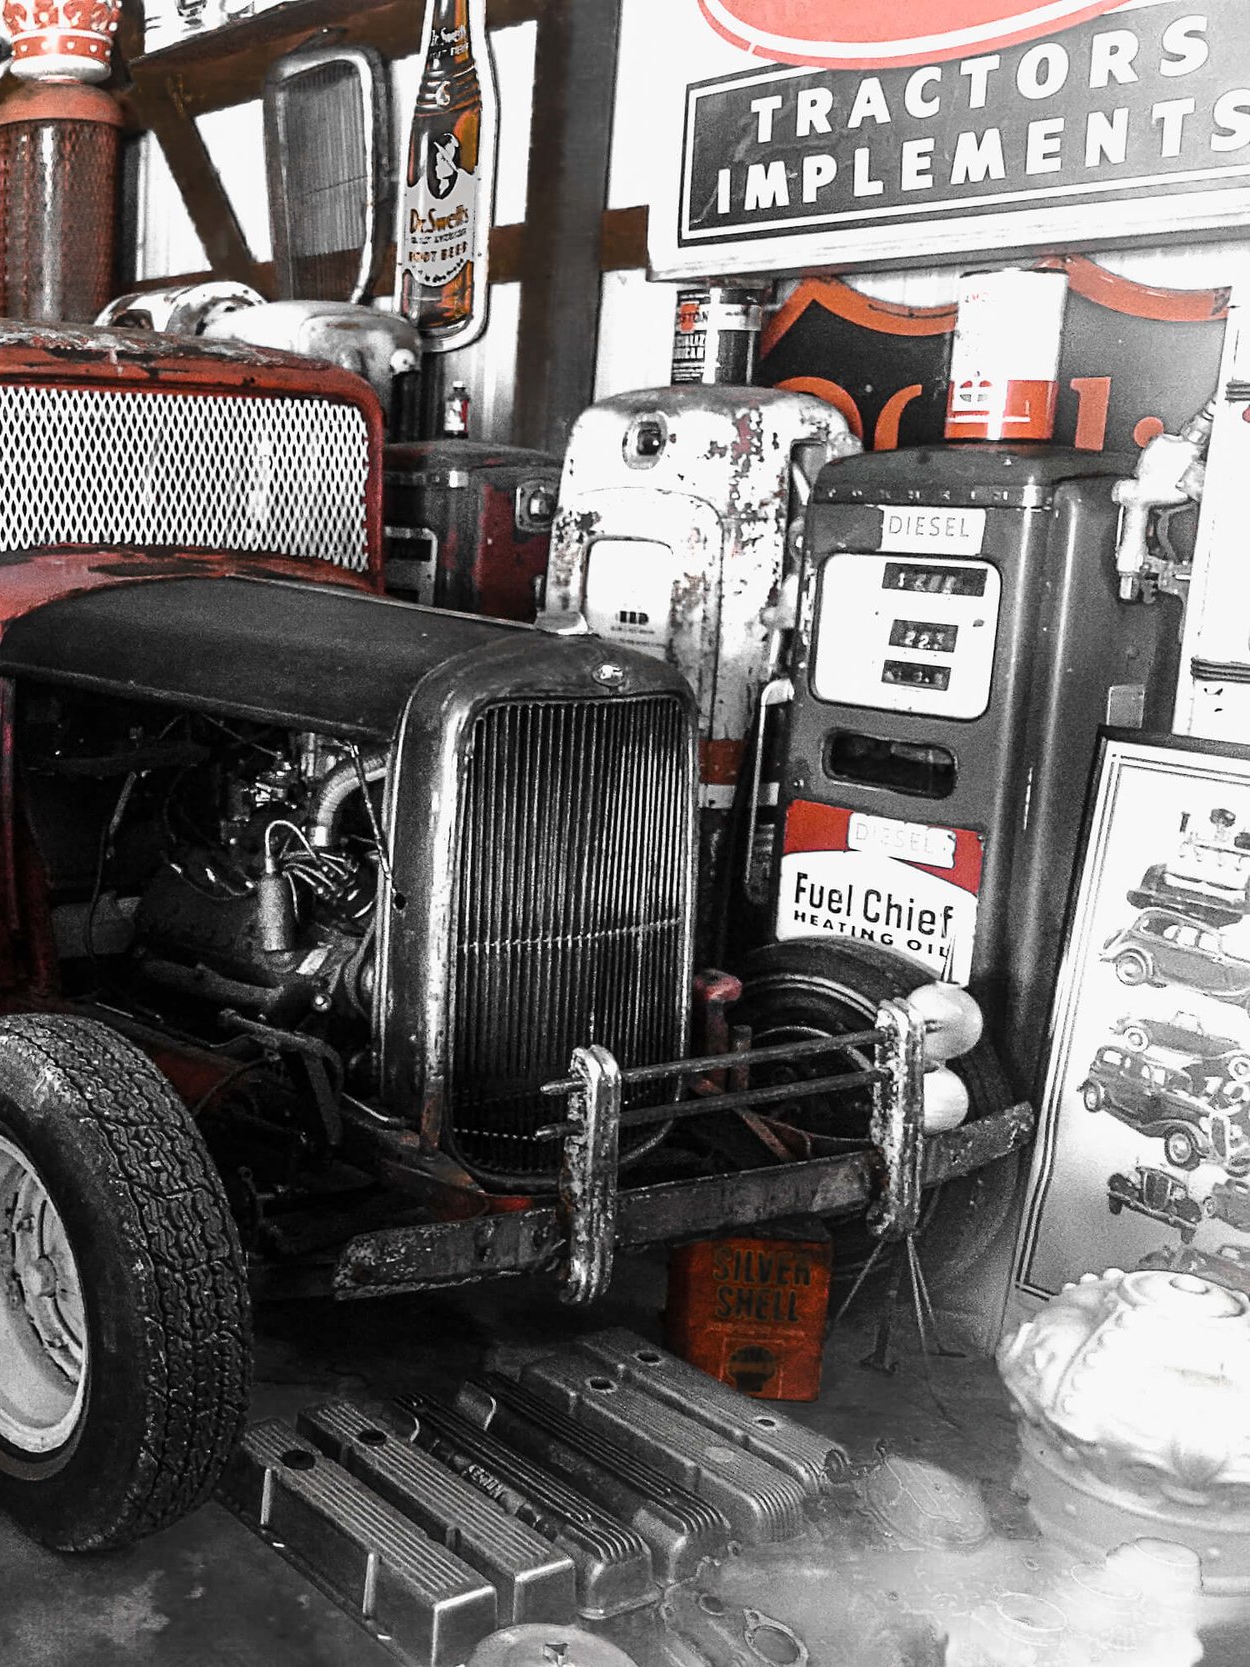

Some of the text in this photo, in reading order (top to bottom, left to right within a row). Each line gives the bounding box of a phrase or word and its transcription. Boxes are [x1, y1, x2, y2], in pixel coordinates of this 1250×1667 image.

[751, 15, 1209, 143] TRACTORS
[717, 87, 1250, 214] IMPLEMENTS
[888, 514, 970, 538] DIESEL
[855, 822, 934, 855] DIESEL
[794, 871, 955, 940] Fuel Chief
[793, 909, 951, 959] HEATING OIL
[713, 1246, 813, 1287] SILVER
[715, 1285, 800, 1324] SHELL
